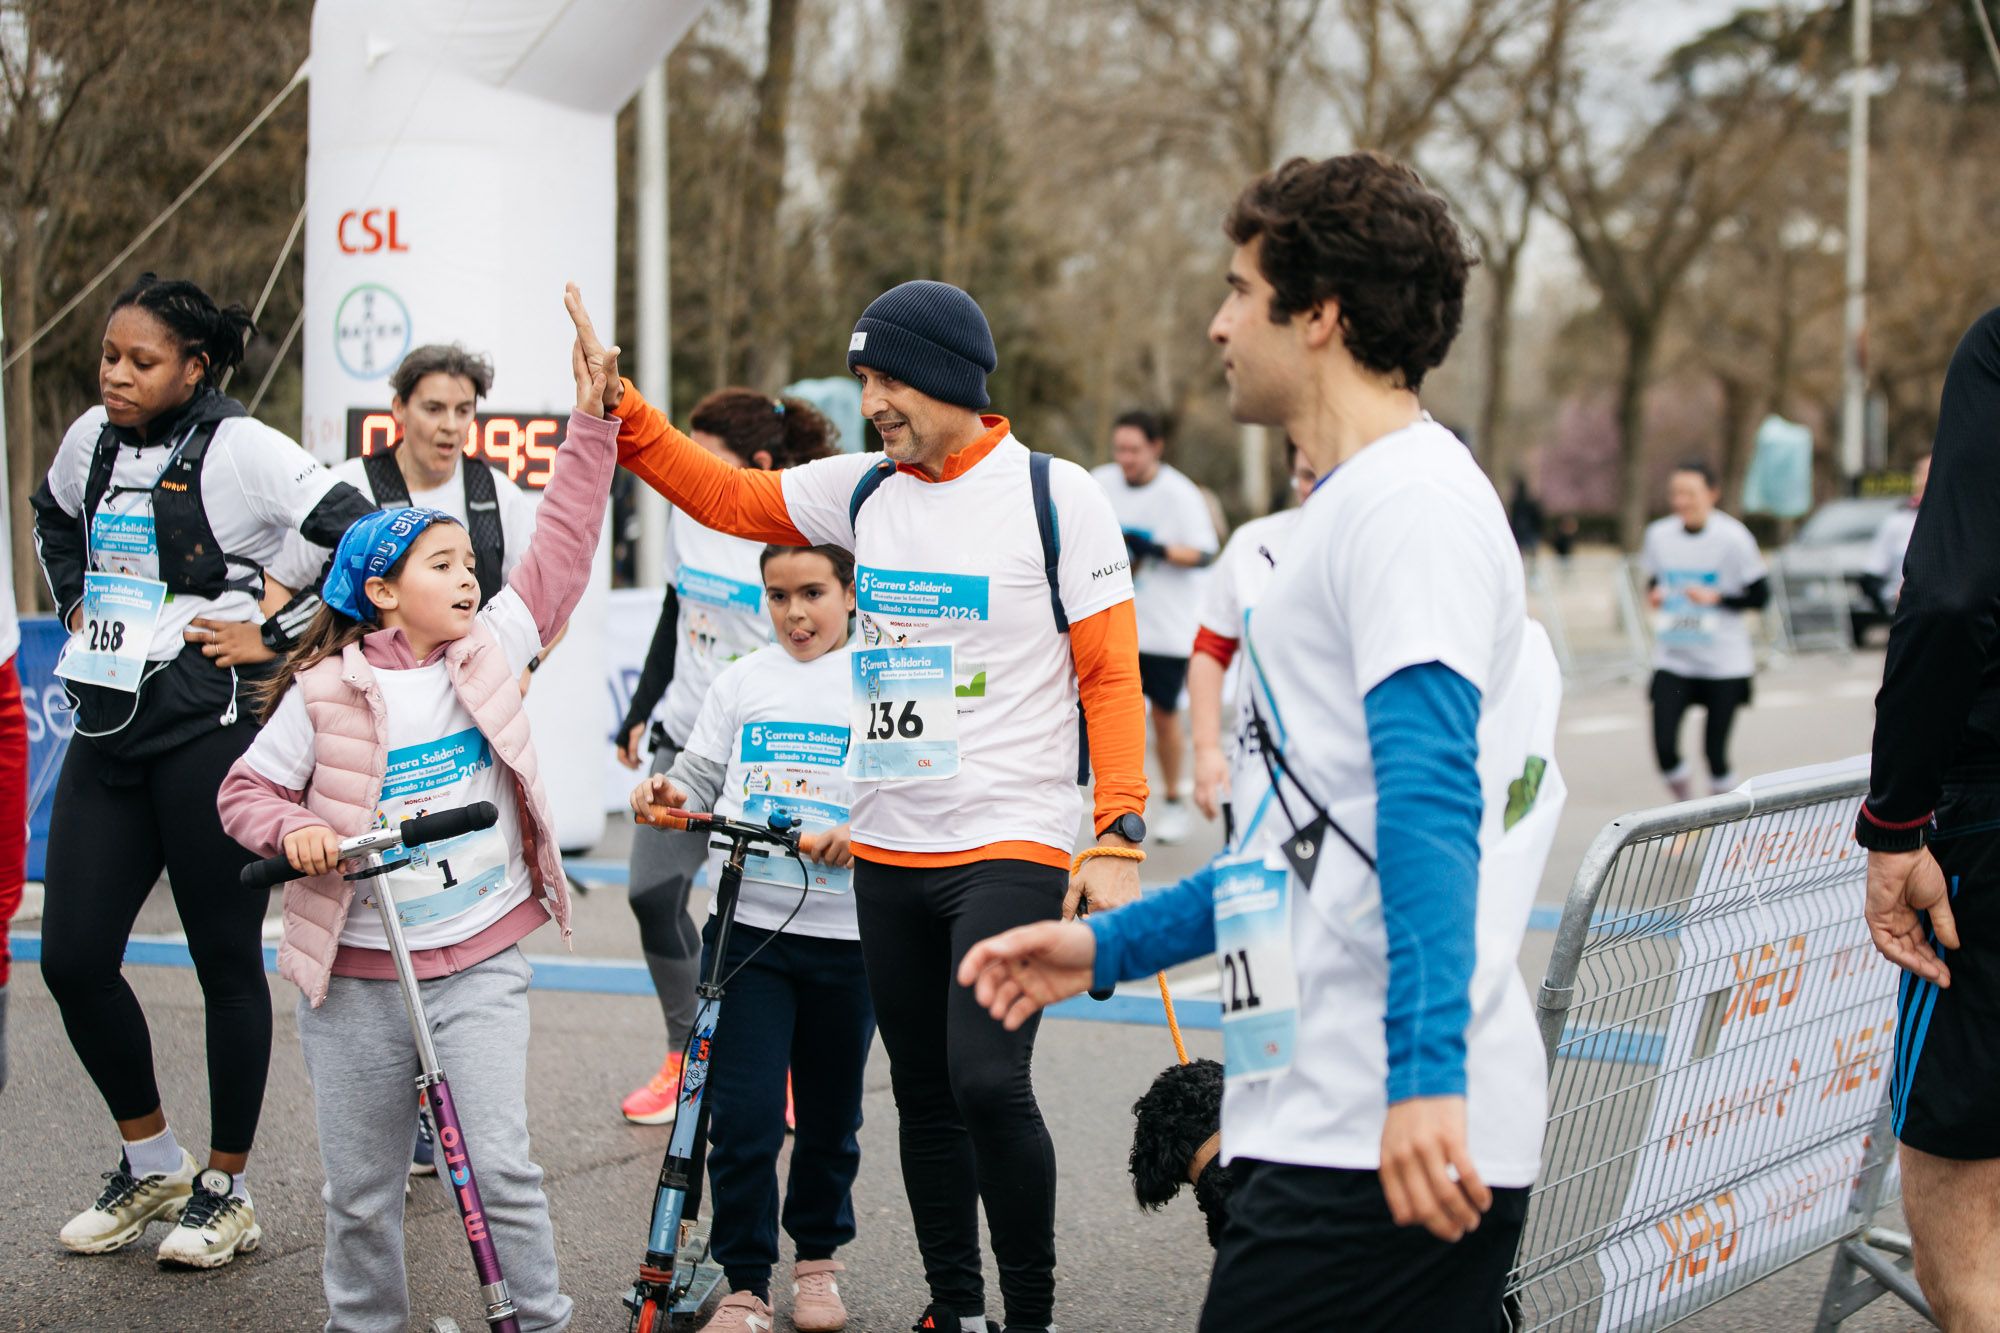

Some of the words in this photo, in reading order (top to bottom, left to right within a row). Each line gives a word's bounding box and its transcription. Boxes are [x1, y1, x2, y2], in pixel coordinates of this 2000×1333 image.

[337, 208, 409, 255] CSL
[121, 522, 155, 535] Solidari
[870, 578, 906, 591] Carrera
[908, 580, 952, 594] Solidaria
[902, 605, 907, 613] 7
[908, 606, 916, 614] de
[917, 607, 938, 615] marzo
[940, 606, 980, 620] 2026
[89, 620, 125, 652] 268
[889, 657, 931, 668] Solidaria
[867, 701, 923, 740] 136
[765, 730, 806, 741] Carrera
[807, 731, 849, 746] Solidari
[385, 758, 419, 774] arrera
[421, 745, 465, 765] Solidaria
[818, 757, 840, 765] marzo
[918, 759, 932, 767] CSL
[390, 783, 418, 795] Sábado
[419, 780, 424, 788] 7
[425, 778, 435, 787] de
[436, 773, 458, 784] marzo
[404, 795, 432, 806] MONCLOA
[437, 859, 458, 890] 1
[1222, 950, 1261, 1014] 21
[440, 1126, 487, 1242] micro
